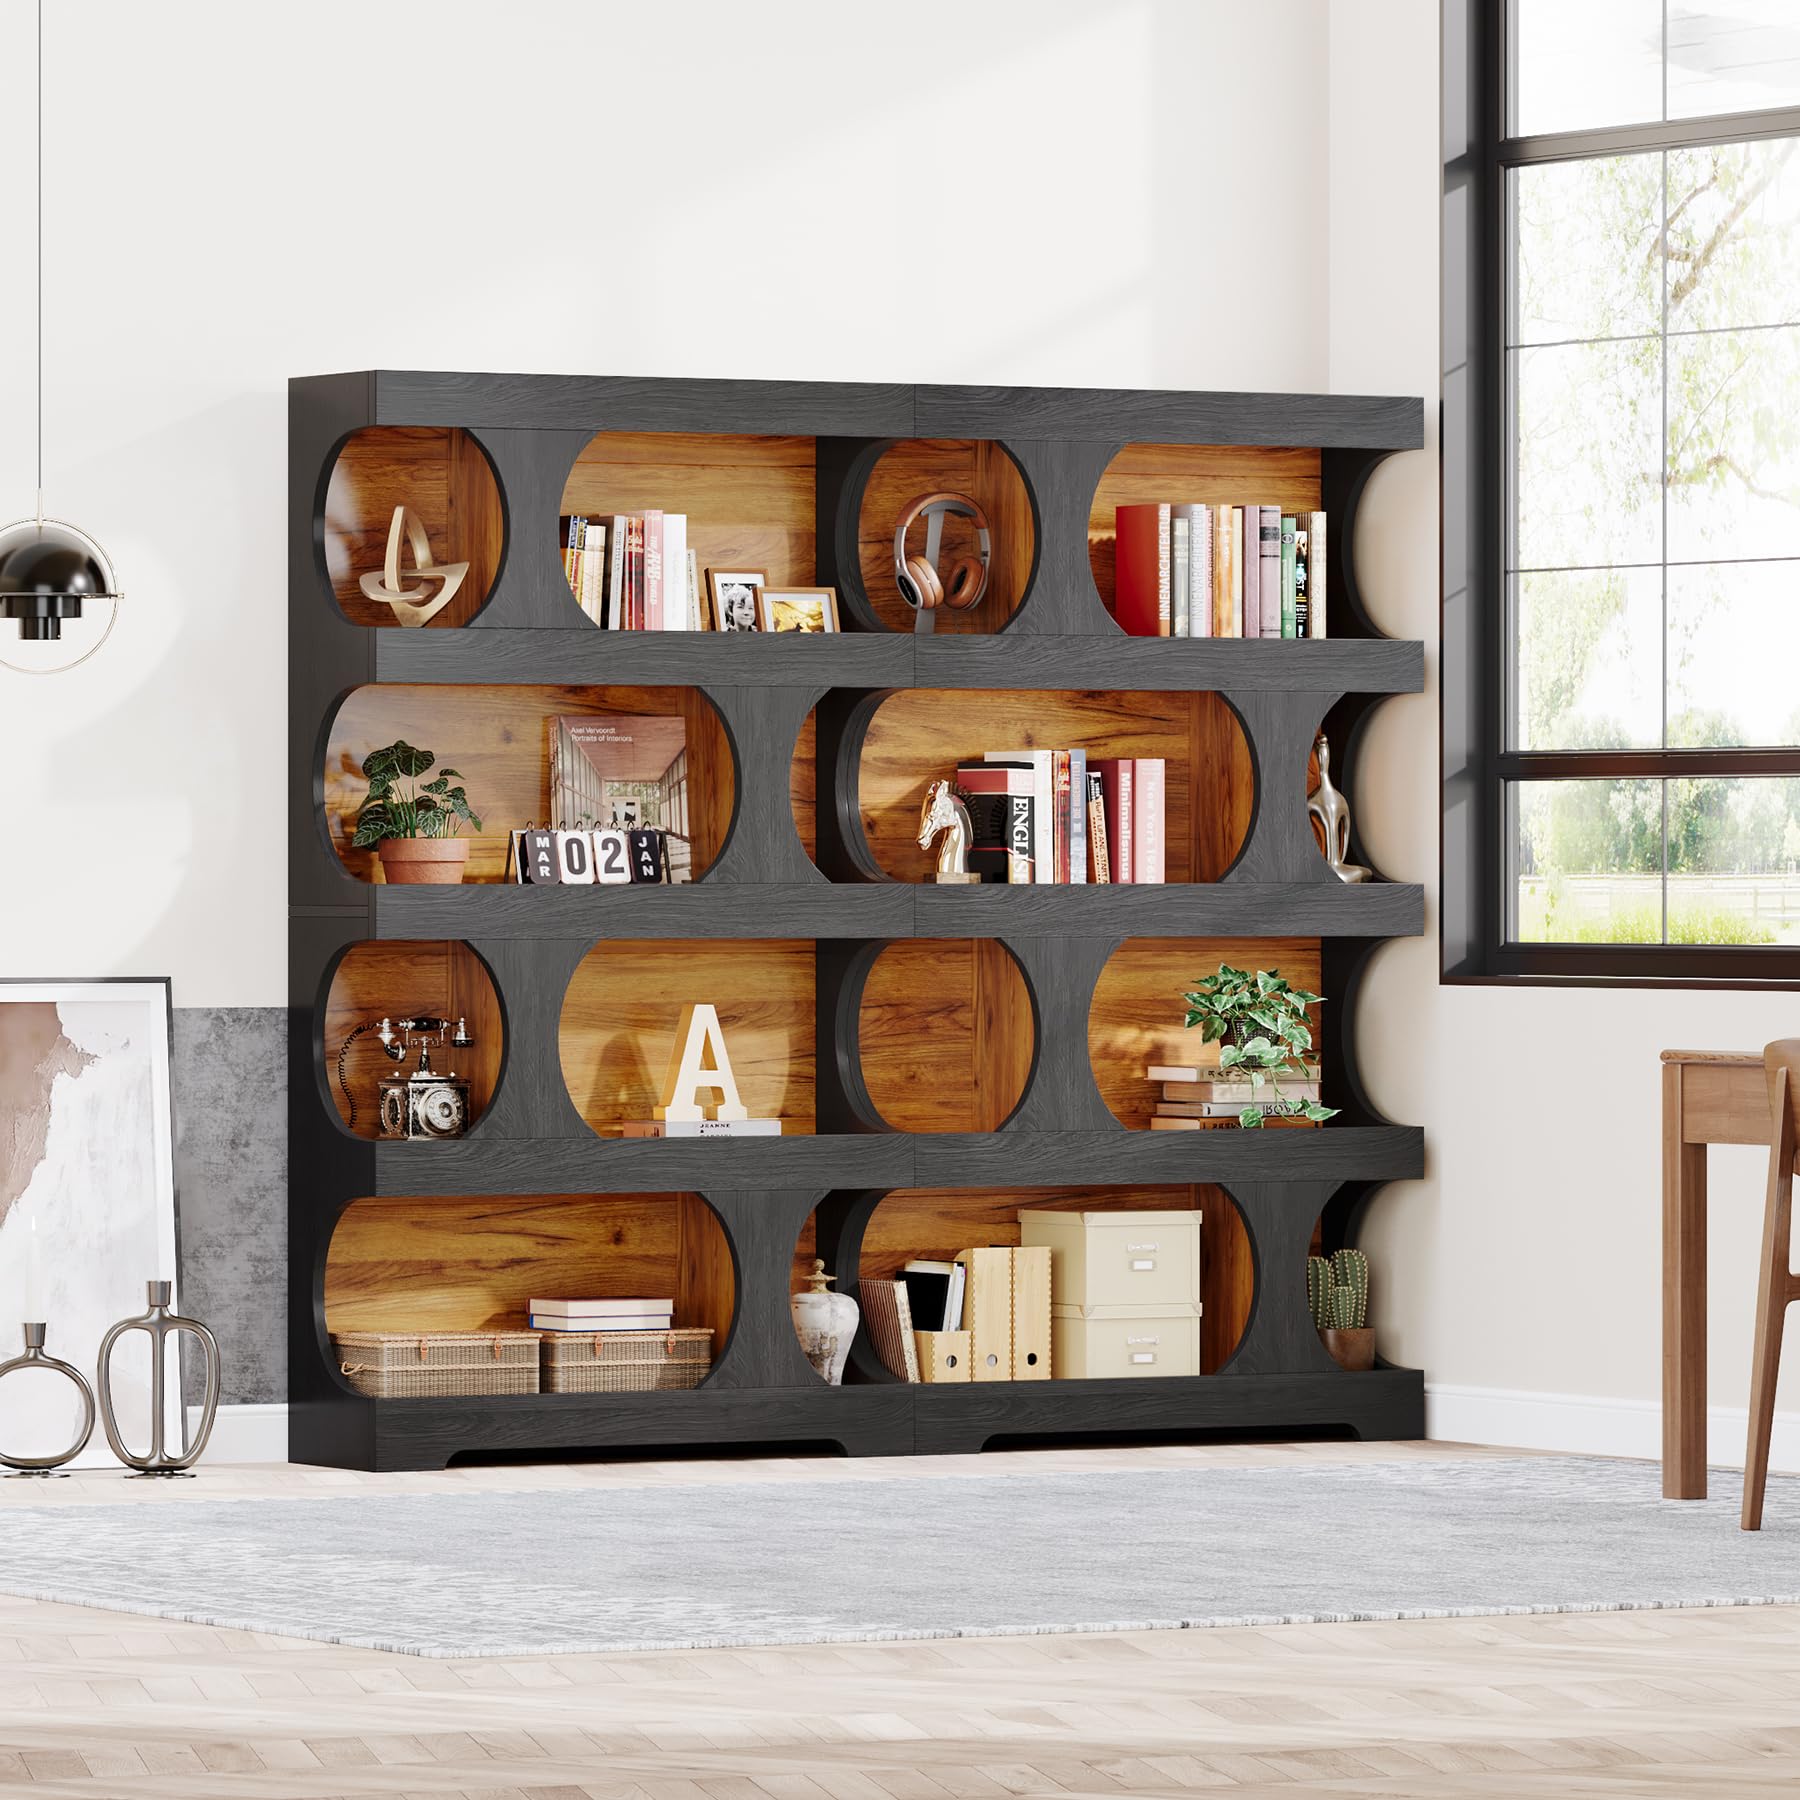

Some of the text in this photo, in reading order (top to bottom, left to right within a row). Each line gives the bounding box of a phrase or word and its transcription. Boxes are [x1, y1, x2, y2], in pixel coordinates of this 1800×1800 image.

[1159, 510, 1170, 620] INNENARCHITEKTUR
[1191, 510, 1204, 620] INNENARCHITEKTUR
[571, 734, 633, 742] Portraits of Interiors
[536, 837, 551, 877] MAR
[638, 837, 655, 876] JAN
[1121, 772, 1131, 881] Minimalismus
[665, 1004, 748, 1121] A
